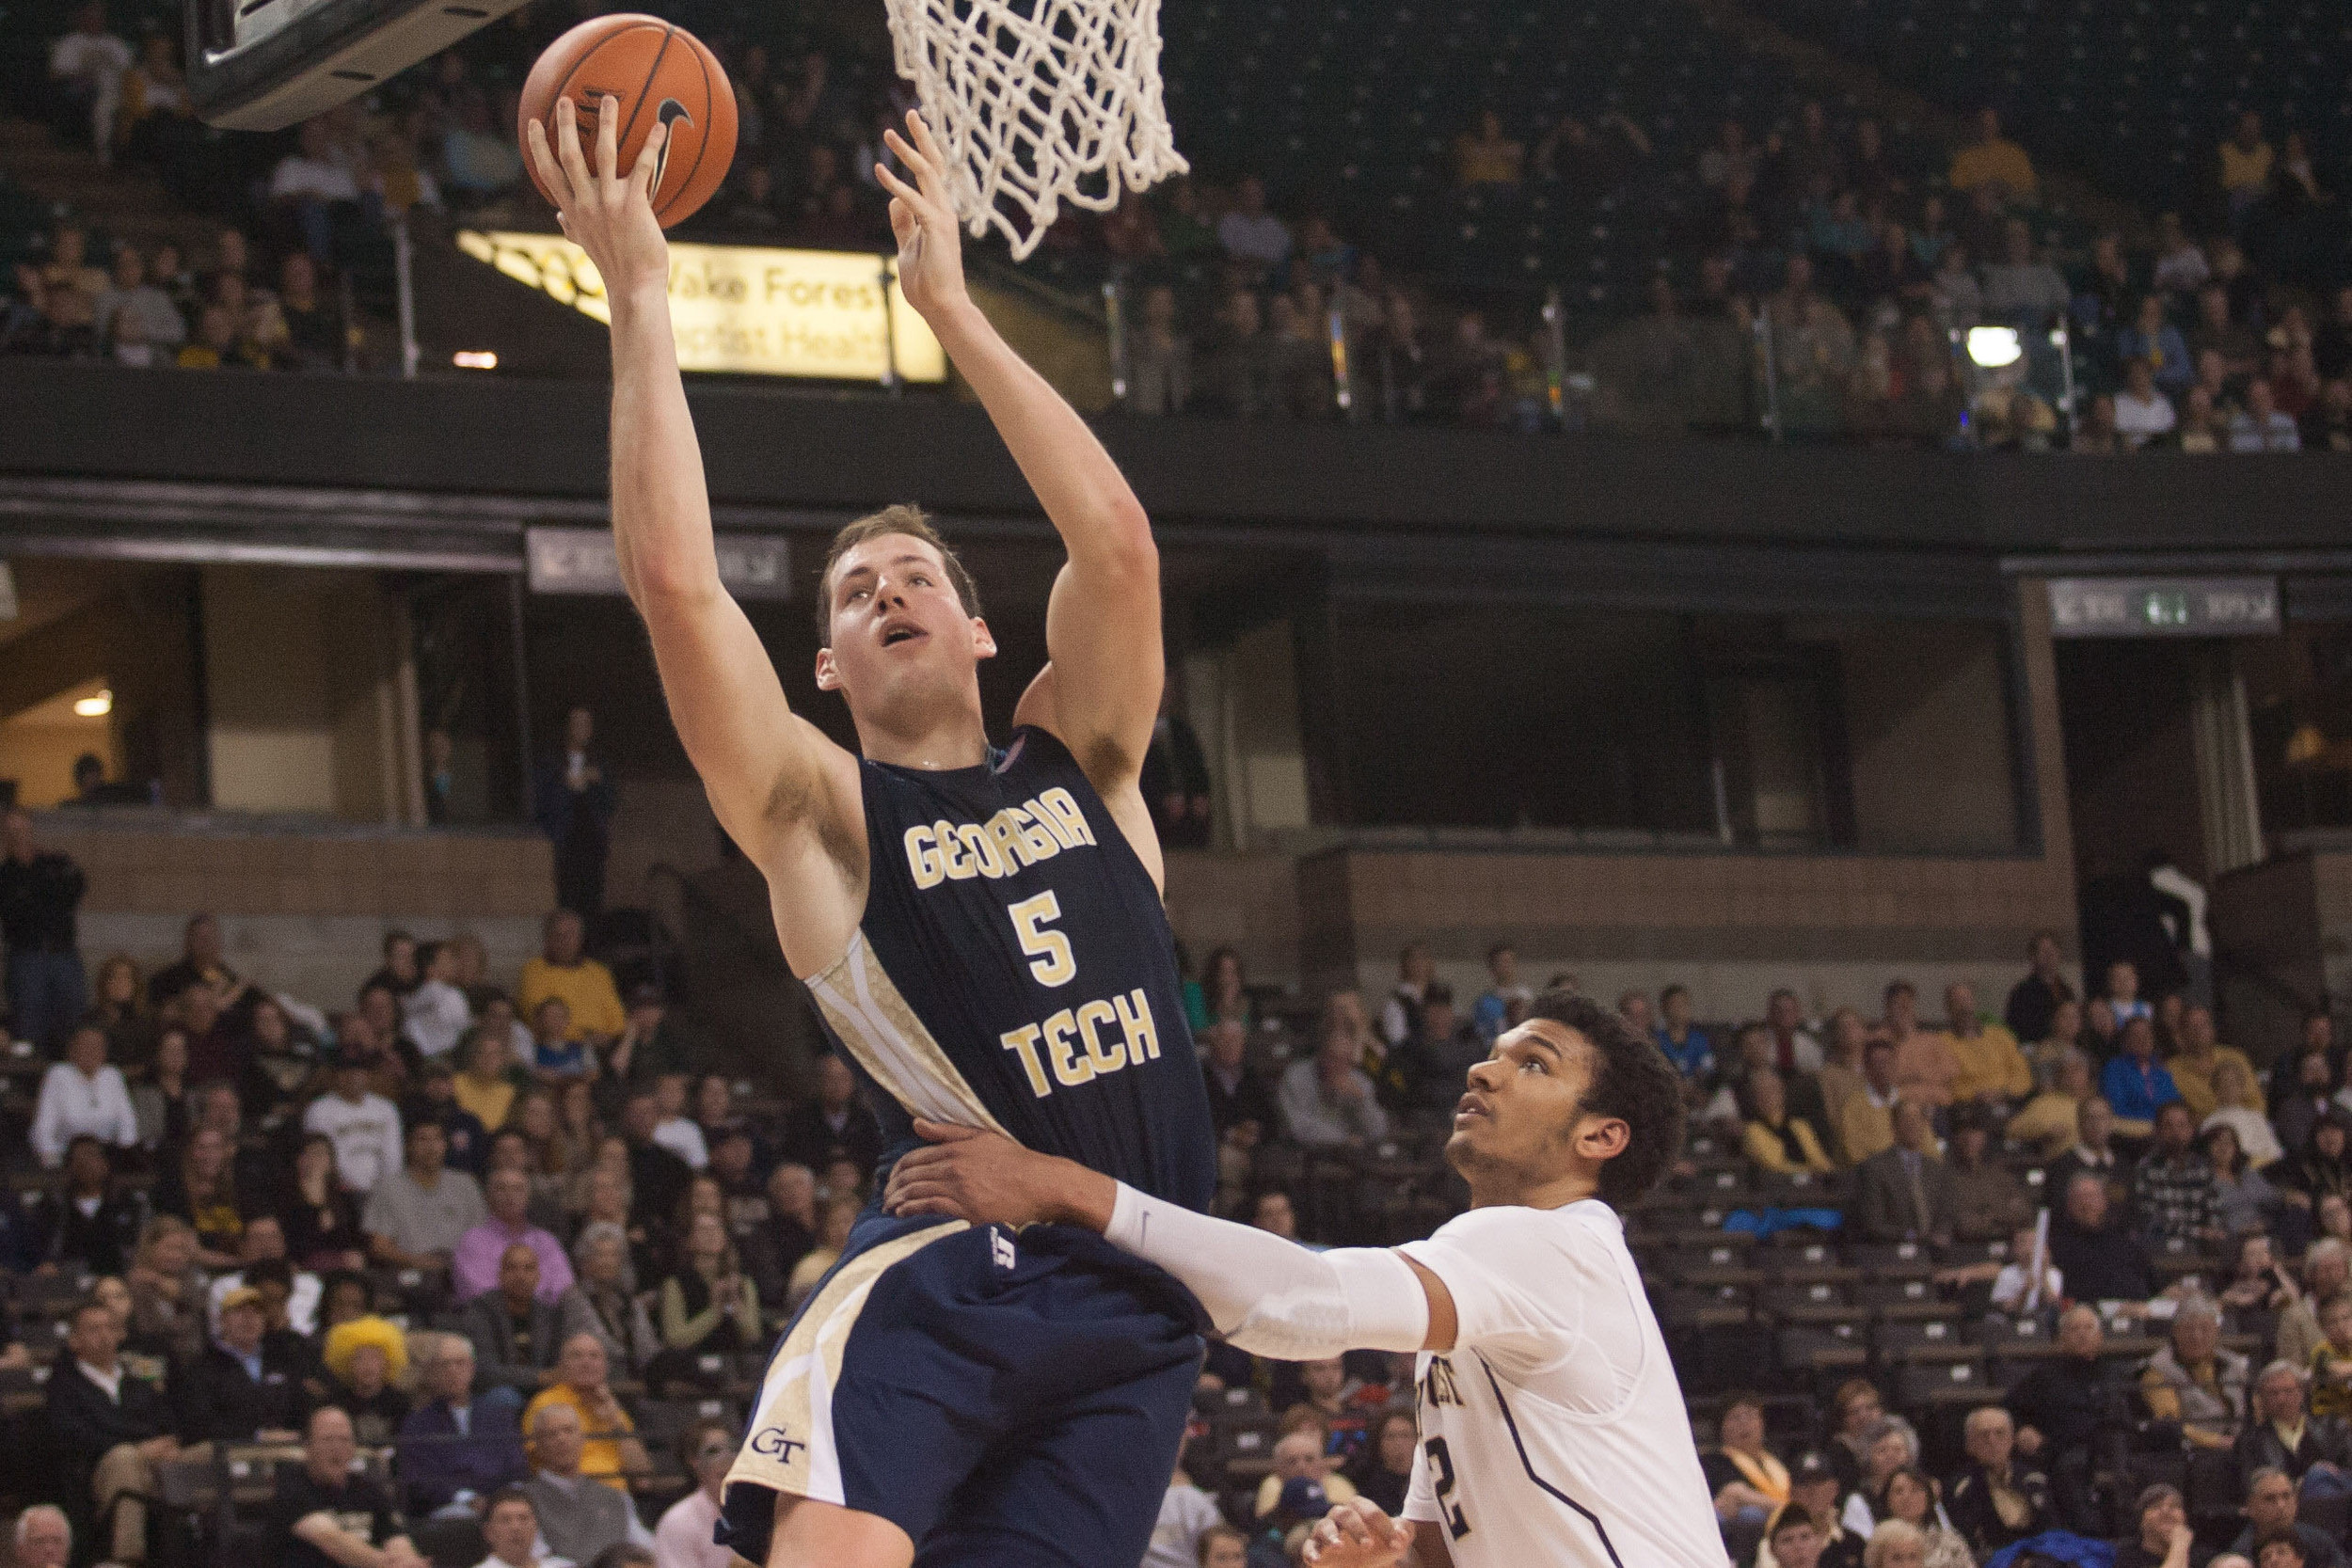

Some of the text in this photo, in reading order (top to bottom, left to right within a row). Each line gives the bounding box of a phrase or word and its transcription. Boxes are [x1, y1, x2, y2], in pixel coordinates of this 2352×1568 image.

[764, 267, 882, 311] Fores
[903, 786, 1097, 890] GEORGIA
[1008, 889, 1076, 988] 5
[1000, 988, 1161, 1099] TECH
[752, 1428, 804, 1464] GT
[1425, 1434, 1471, 1541] 2
